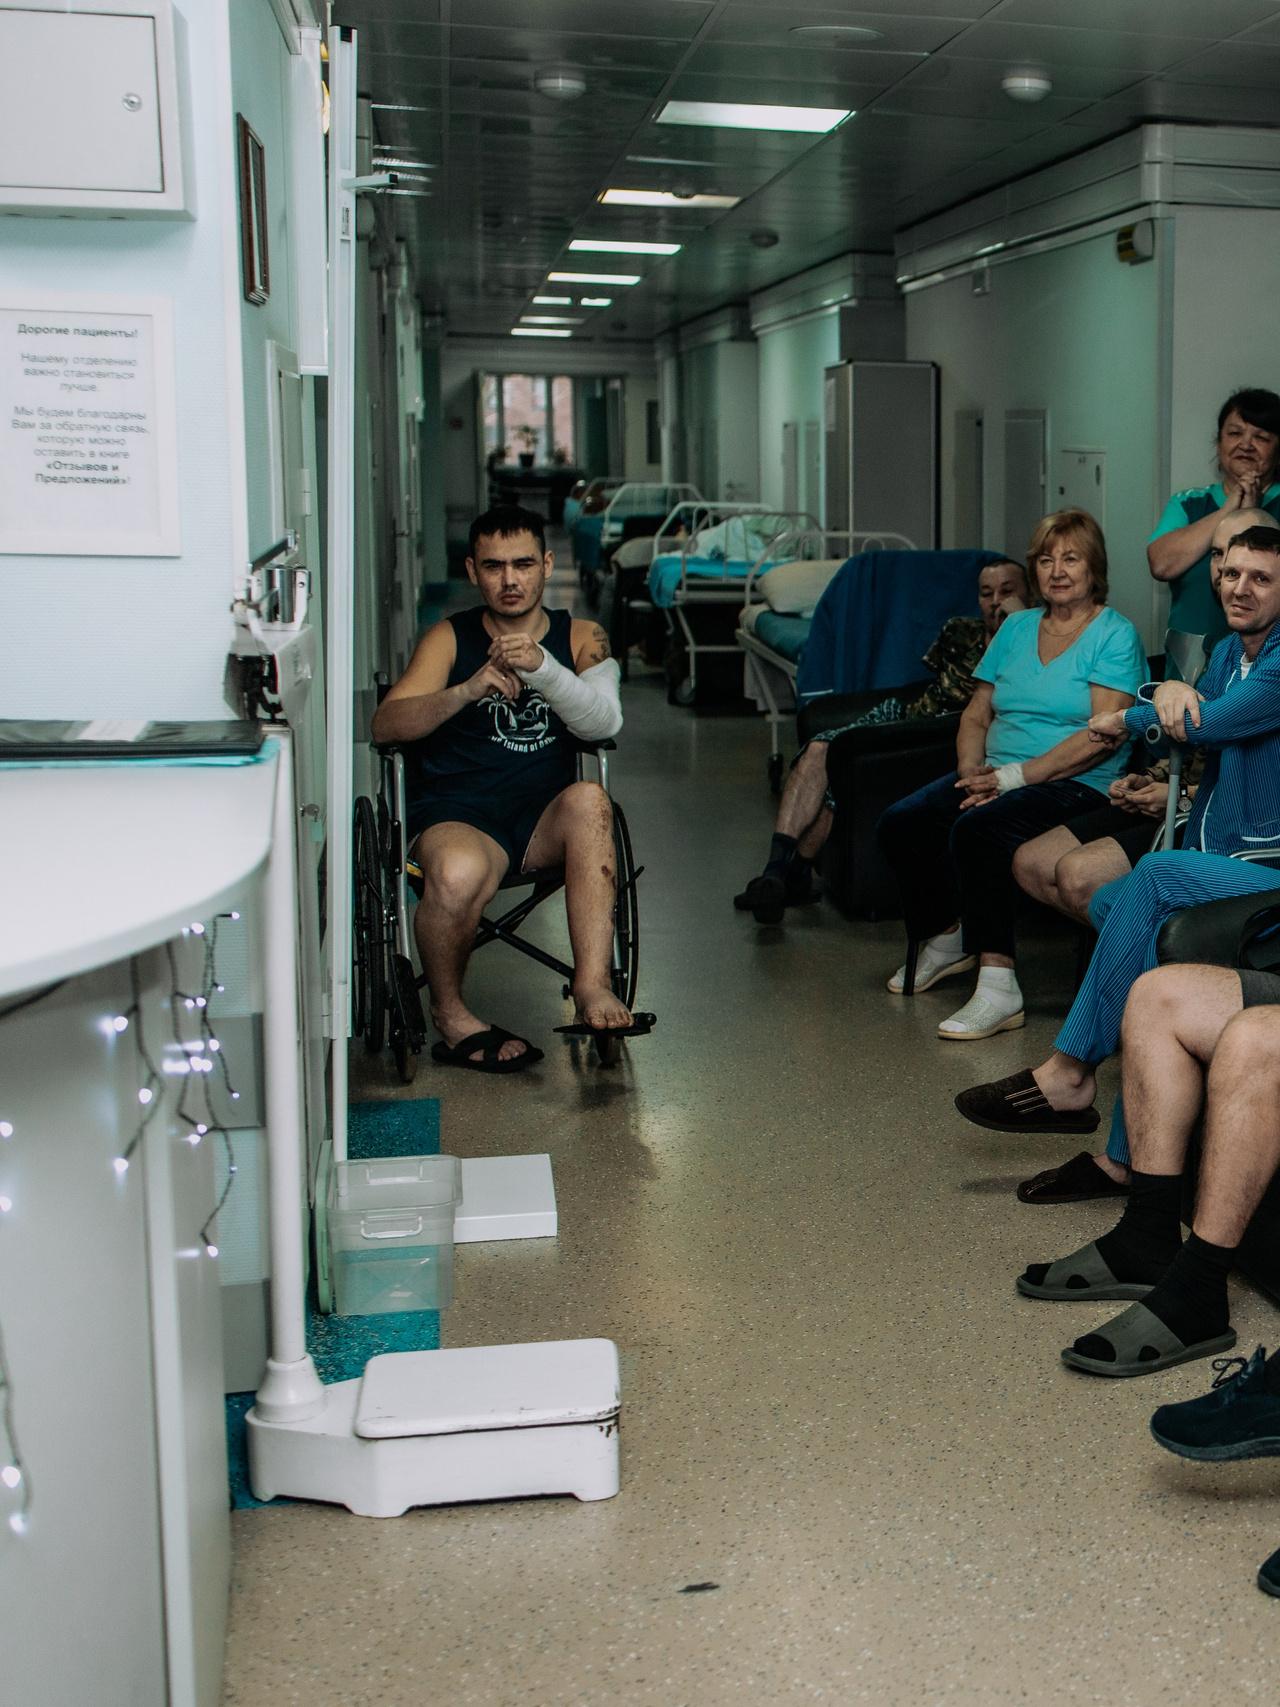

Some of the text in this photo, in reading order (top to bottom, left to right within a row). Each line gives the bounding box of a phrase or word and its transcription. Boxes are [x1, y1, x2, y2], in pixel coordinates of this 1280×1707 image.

[17, 323, 139, 339] Дорогие пациенты!
[20, 352, 138, 366] Нашему отделению
[23, 368, 135, 380] важно становиться
[59, 382, 101, 393] лучше.
[14, 406, 147, 420] Мы будем благодарны
[11, 419, 36, 429] Вам
[39, 422, 52, 430] за
[55, 421, 112, 433] обратную
[37, 436, 126, 446] которую можно
[33, 448, 87, 458] оставить
[99, 450, 130, 459] книге
[46, 460, 108, 471] «Отзывов
